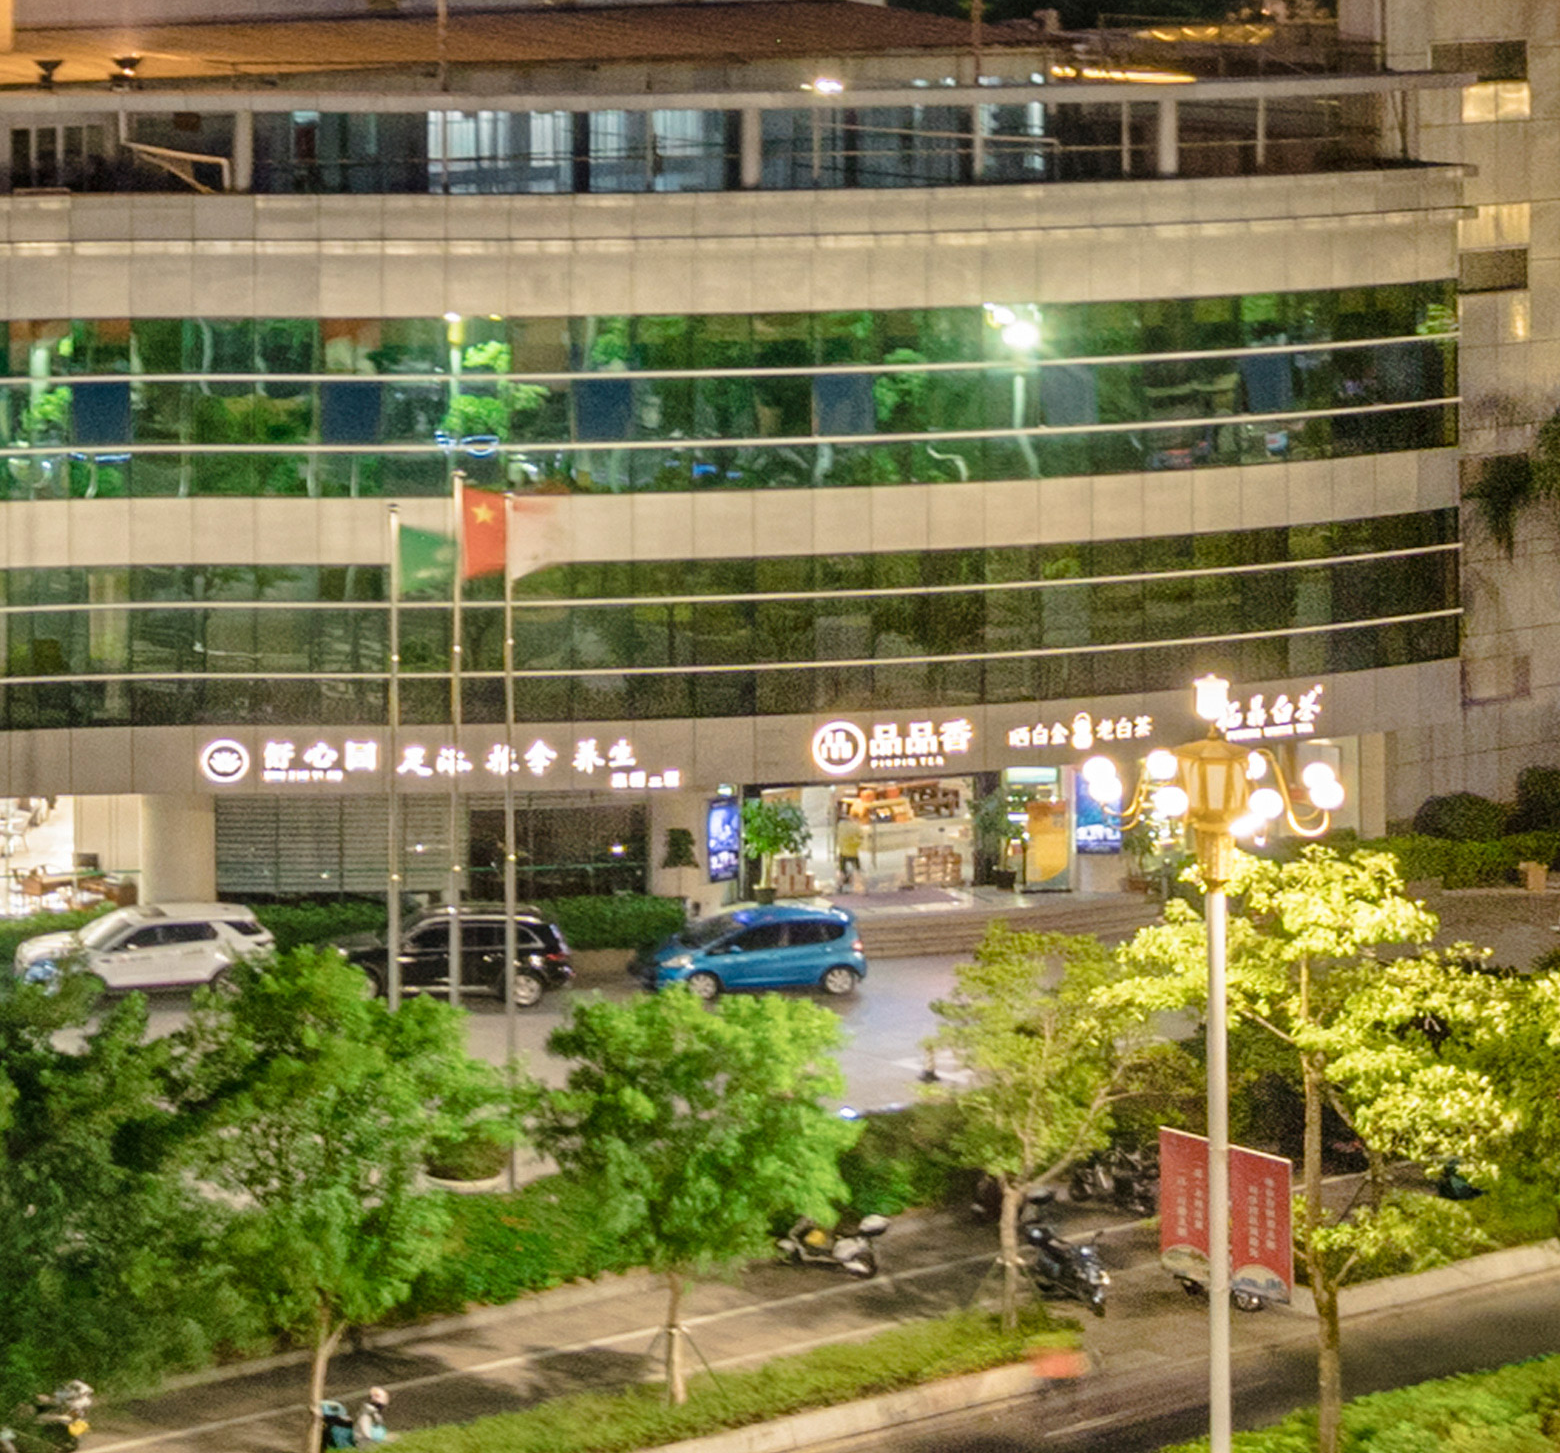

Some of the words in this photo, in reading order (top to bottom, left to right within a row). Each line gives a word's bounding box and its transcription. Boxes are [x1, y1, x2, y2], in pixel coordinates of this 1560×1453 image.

[869, 718, 974, 757] 品品香
[1096, 715, 1153, 741] 老白茶
[571, 738, 637, 775] 养生
